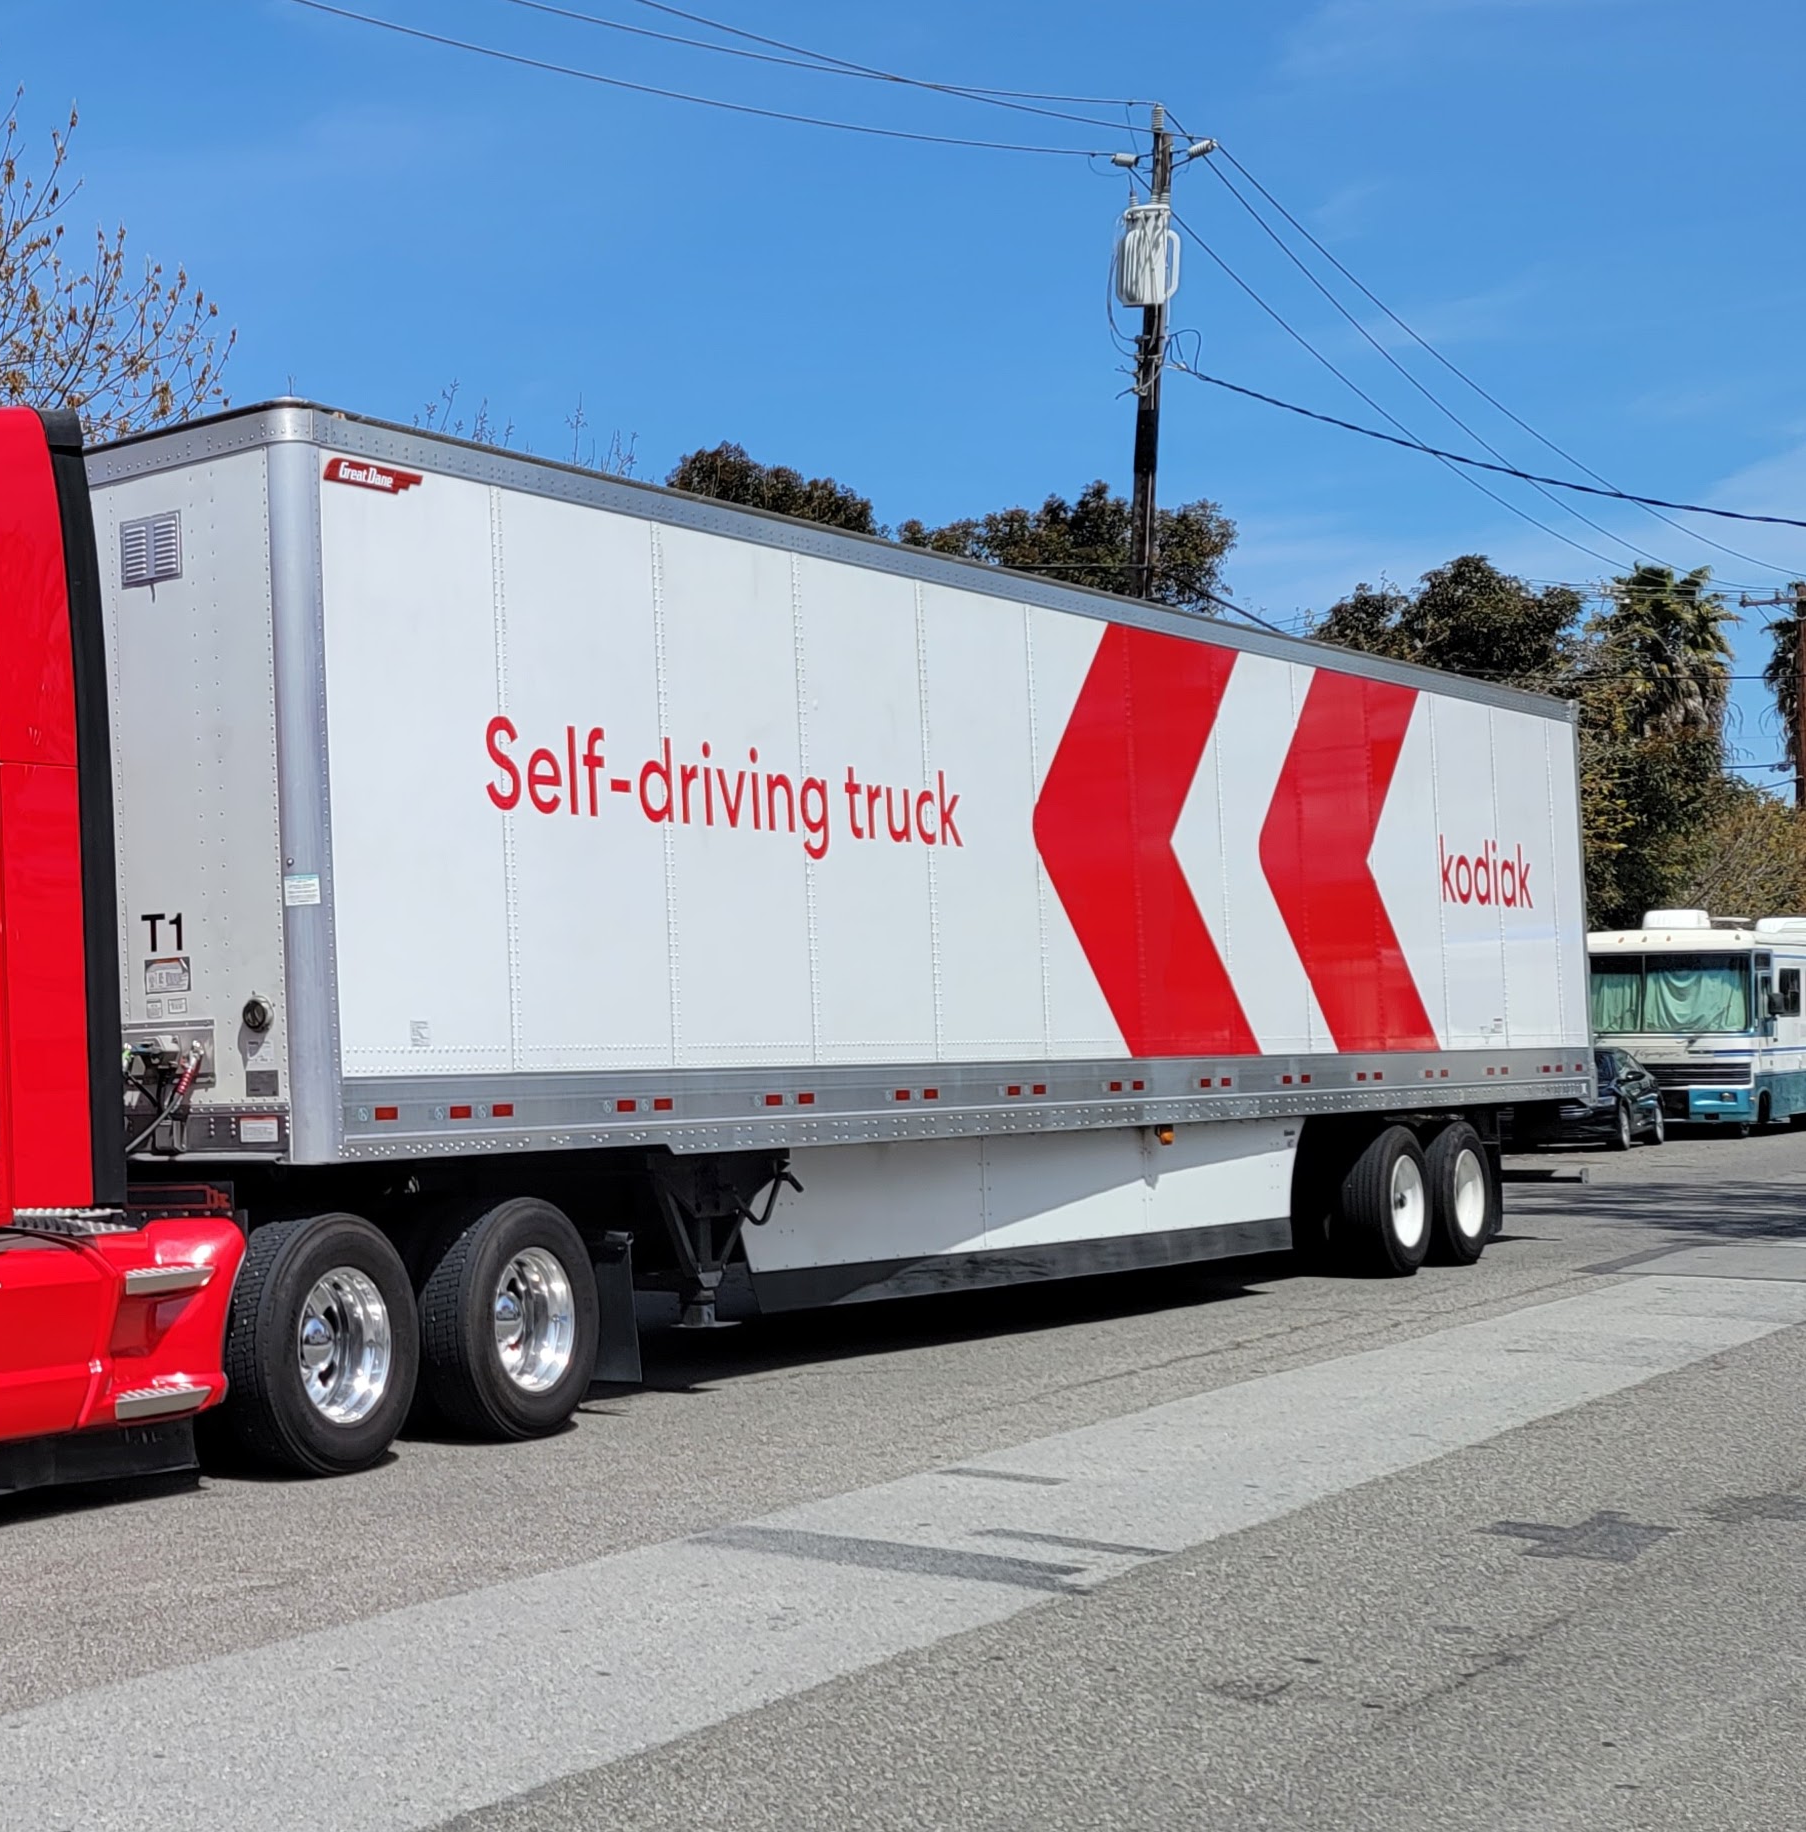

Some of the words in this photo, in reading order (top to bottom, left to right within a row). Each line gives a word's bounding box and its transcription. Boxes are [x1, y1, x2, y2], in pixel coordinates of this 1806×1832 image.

[339, 462, 366, 482] Great
[368, 467, 394, 487] Dane
[485, 715, 831, 860] Self-driving
[843, 766, 964, 848] truck
[1439, 833, 1534, 910] kodiak
[140, 912, 184, 952] T1
